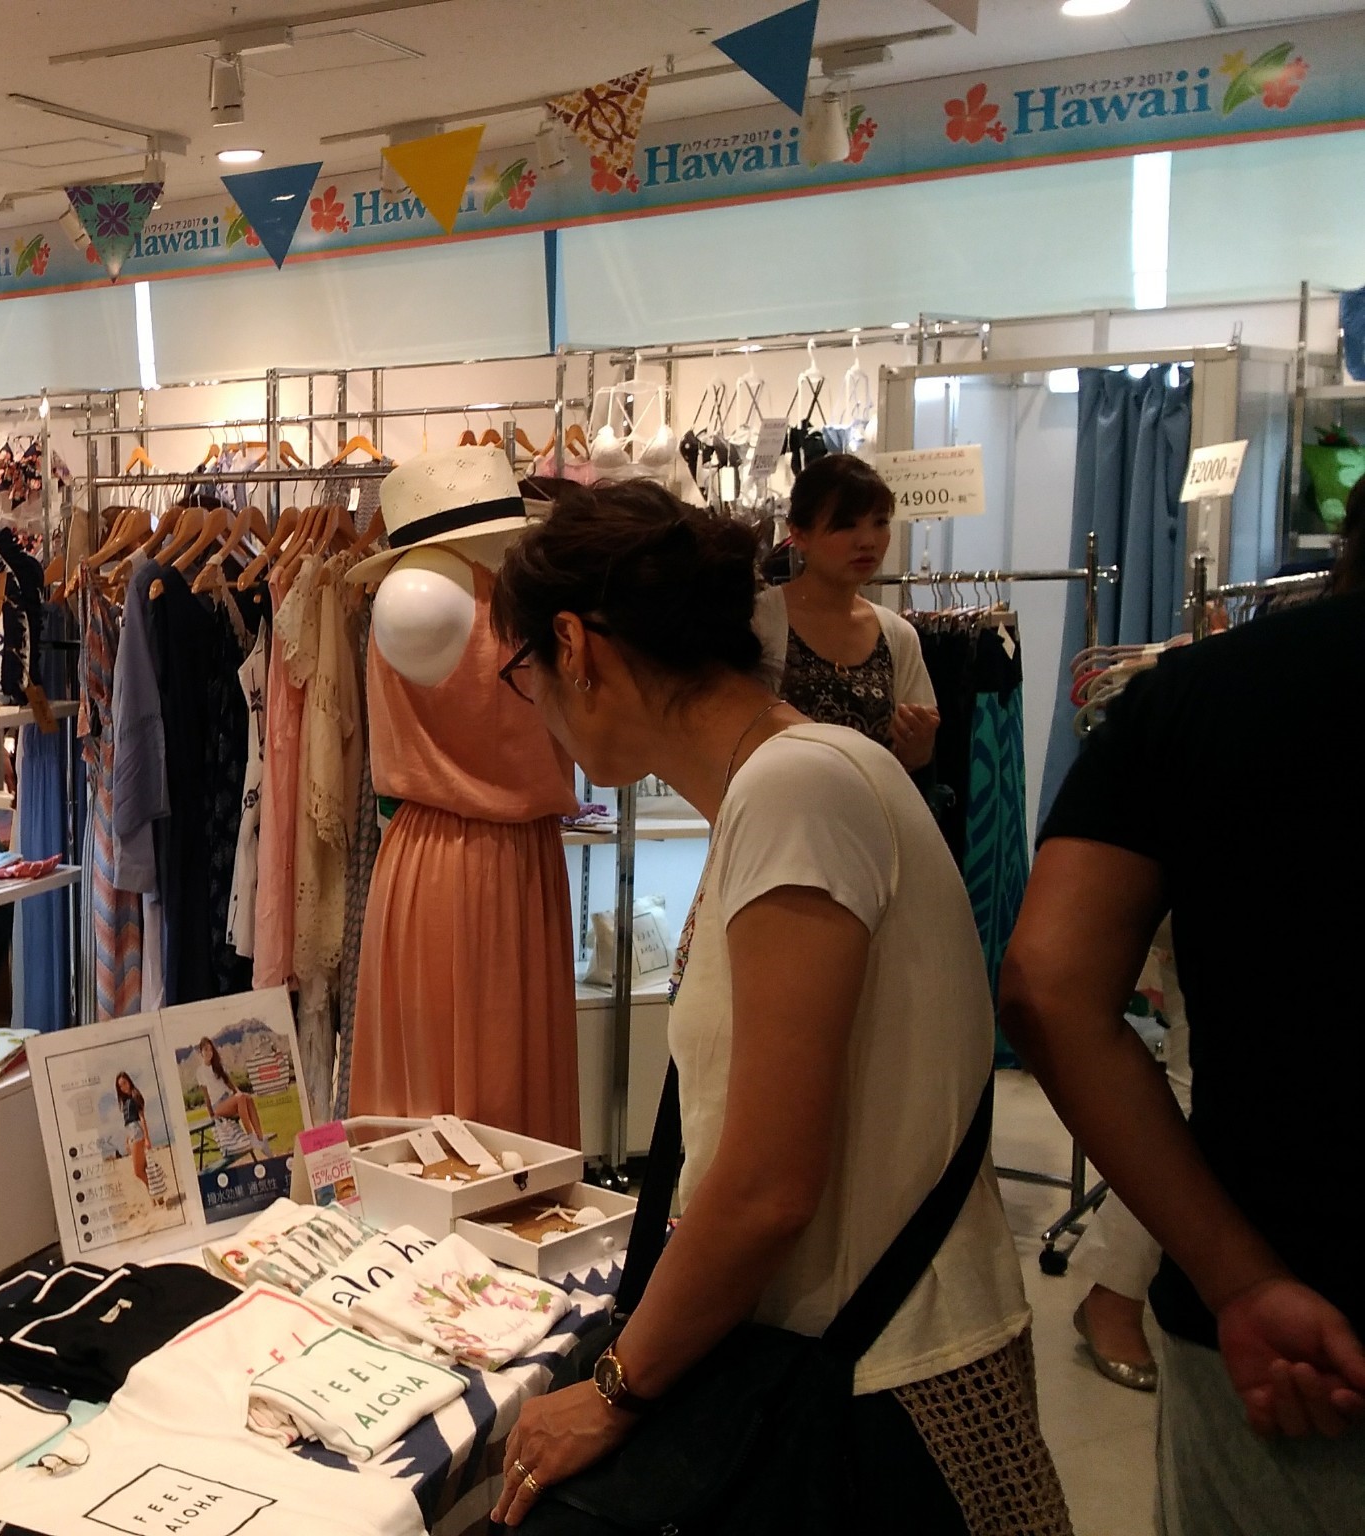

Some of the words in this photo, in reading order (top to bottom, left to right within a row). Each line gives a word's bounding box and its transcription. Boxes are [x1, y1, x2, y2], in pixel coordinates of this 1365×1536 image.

[1012, 67, 1212, 137] Hawaii
[1060, 78, 1135, 98] ハワイフェア
[1138, 71, 1173, 88] 2017
[643, 126, 801, 188] Hawaii
[682, 134, 740, 152] ハワイフェア
[742, 129, 770, 144] 2017
[352, 175, 477, 228] Hawi
[182, 217, 201, 229] 2017
[893, 488, 950, 507] 4900
[310, 1360, 388, 1404] FEEL
[354, 1374, 430, 1430] ALOHA
[132, 1483, 193, 1524] FEEL
[164, 1493, 224, 1534] ALOHA
